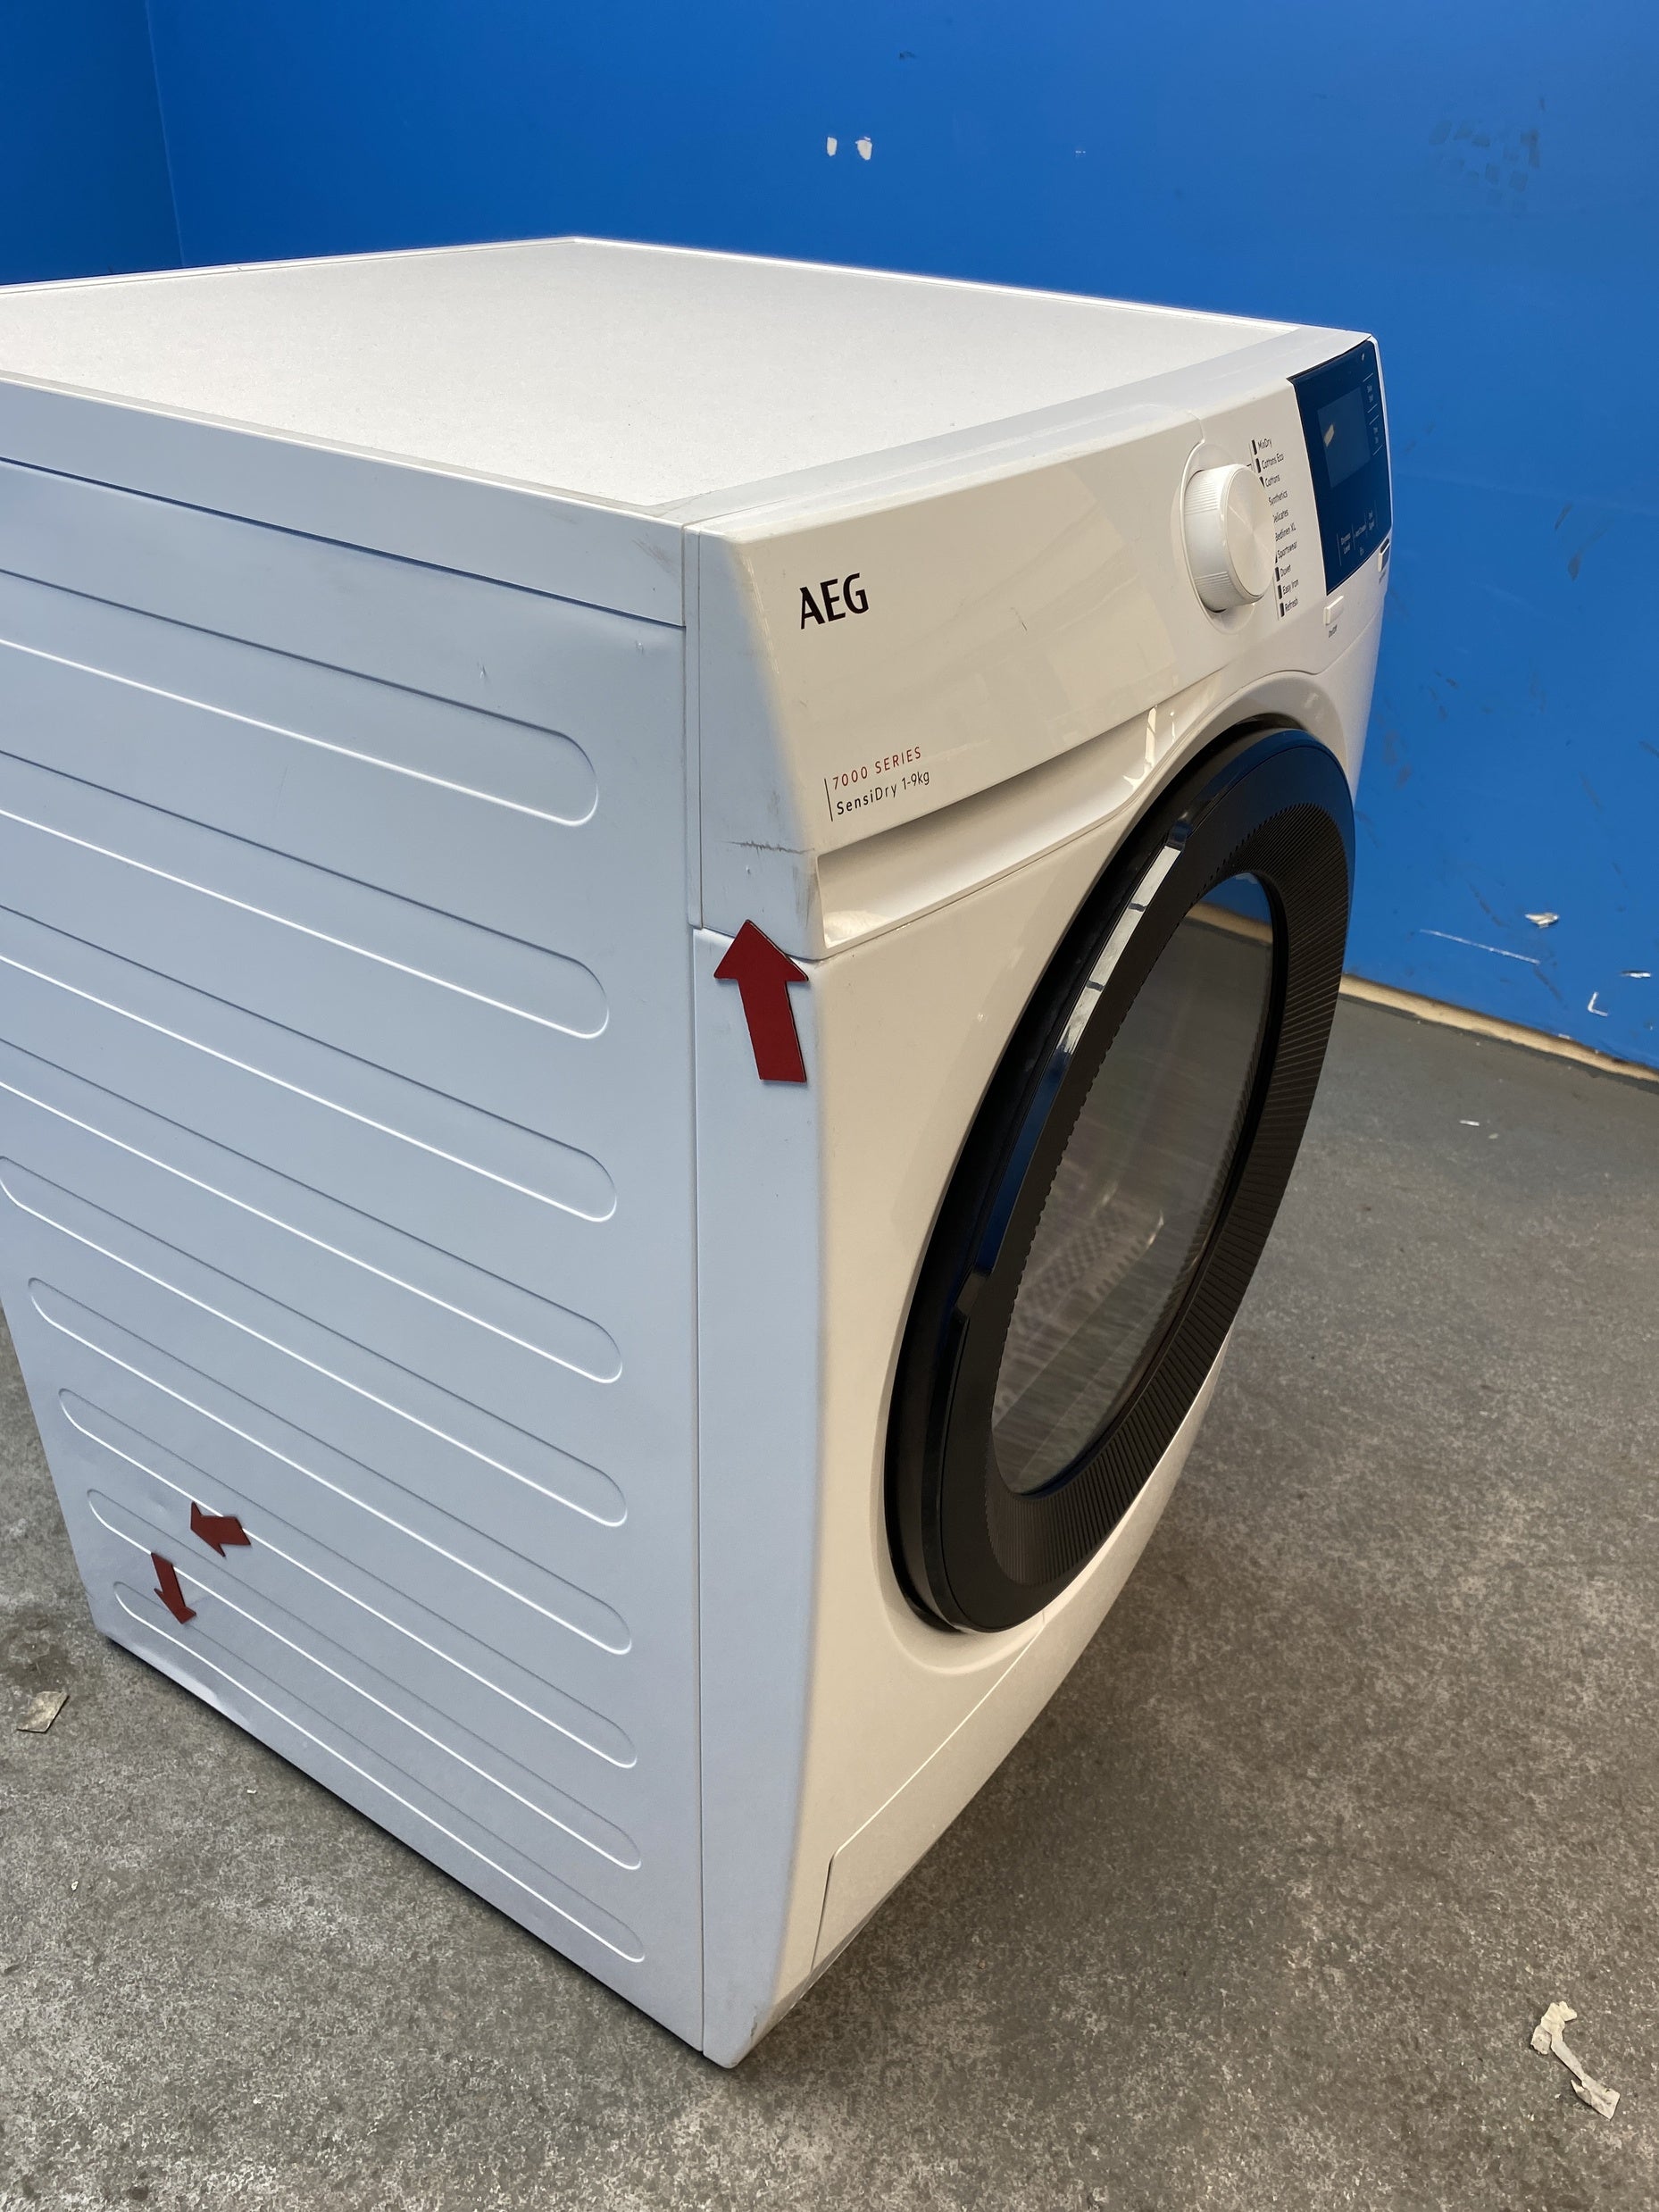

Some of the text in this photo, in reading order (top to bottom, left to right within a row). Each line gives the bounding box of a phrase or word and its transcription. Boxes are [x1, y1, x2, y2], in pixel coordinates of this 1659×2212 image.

[1262, 456, 1277, 469] Cottons
[1265, 474, 1280, 487] Cottons
[1268, 490, 1288, 506] Synthetics
[1277, 541, 1297, 559] Sportswear
[1280, 564, 1291, 577] Duvet
[799, 572, 869, 630] AEG
[1284, 597, 1298, 613] Refresh
[832, 747, 921, 790] 7000 SERIES
[836, 770, 930, 815] SensiDry 1-9kg
